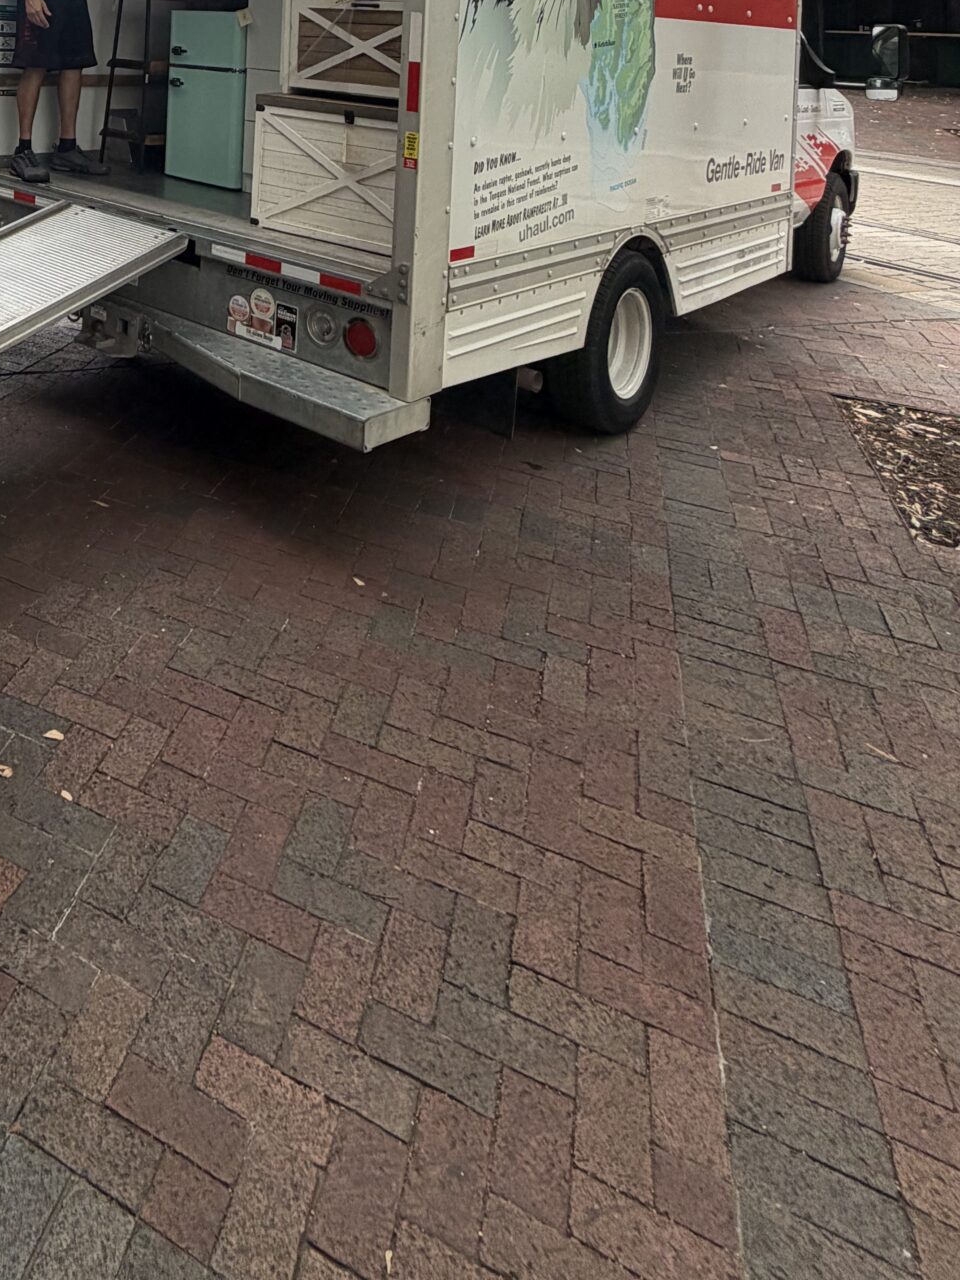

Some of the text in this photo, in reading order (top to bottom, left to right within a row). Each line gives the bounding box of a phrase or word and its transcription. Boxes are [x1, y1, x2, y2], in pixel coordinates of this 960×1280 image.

[676, 53, 693, 65] Where
[676, 80, 692, 93] Next?
[474, 161, 484, 175] DID
[486, 157, 499, 171] YOU
[706, 149, 785, 183] Gentle-Ride Van
[519, 209, 575, 242] uhaul.com
[226, 264, 249, 281] Don't
[250, 272, 280, 288] Forget
[281, 279, 302, 294] Your
[304, 286, 339, 306] Moving
